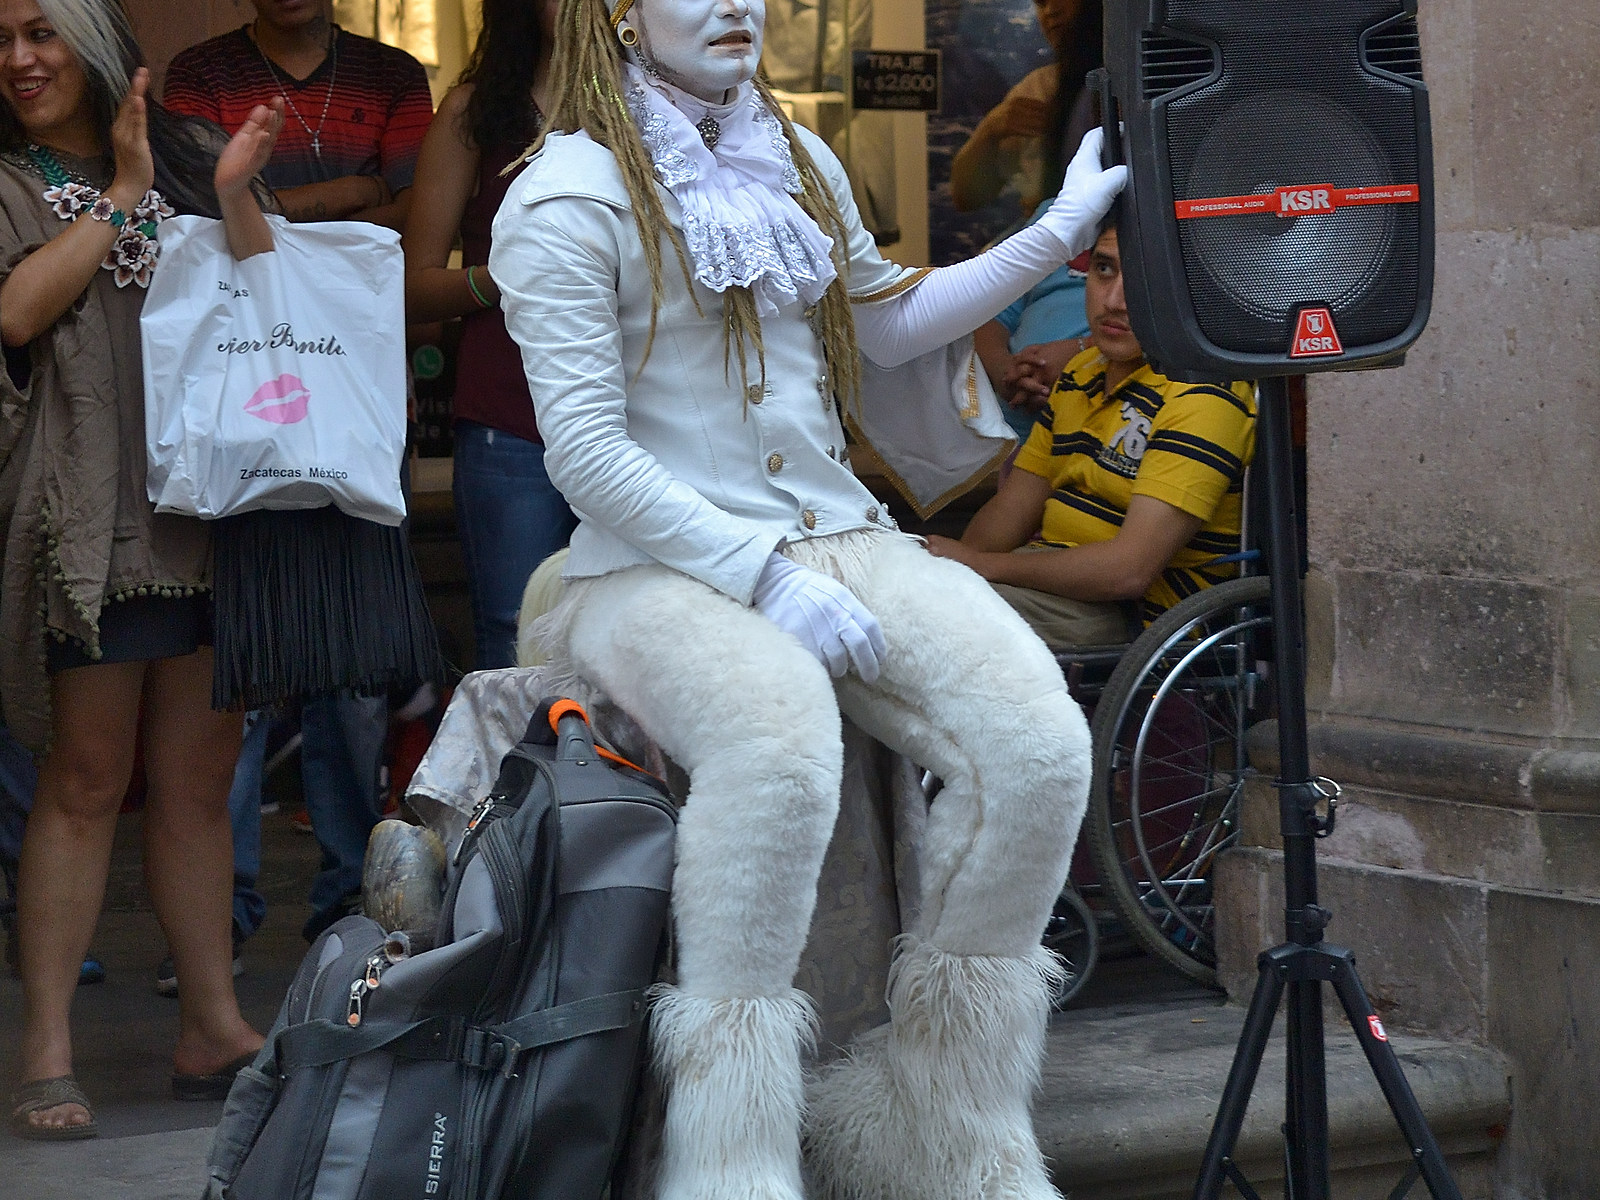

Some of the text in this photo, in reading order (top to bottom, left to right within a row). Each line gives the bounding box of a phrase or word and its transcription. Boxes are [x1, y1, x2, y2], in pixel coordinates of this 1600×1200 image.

[1190, 188, 1412, 212] PROFESSIONAL AUDIO KSR PROFESSIONAL AUDIO
[1299, 336, 1334, 352] KSR
[240, 466, 348, 480] Zacatecas México
